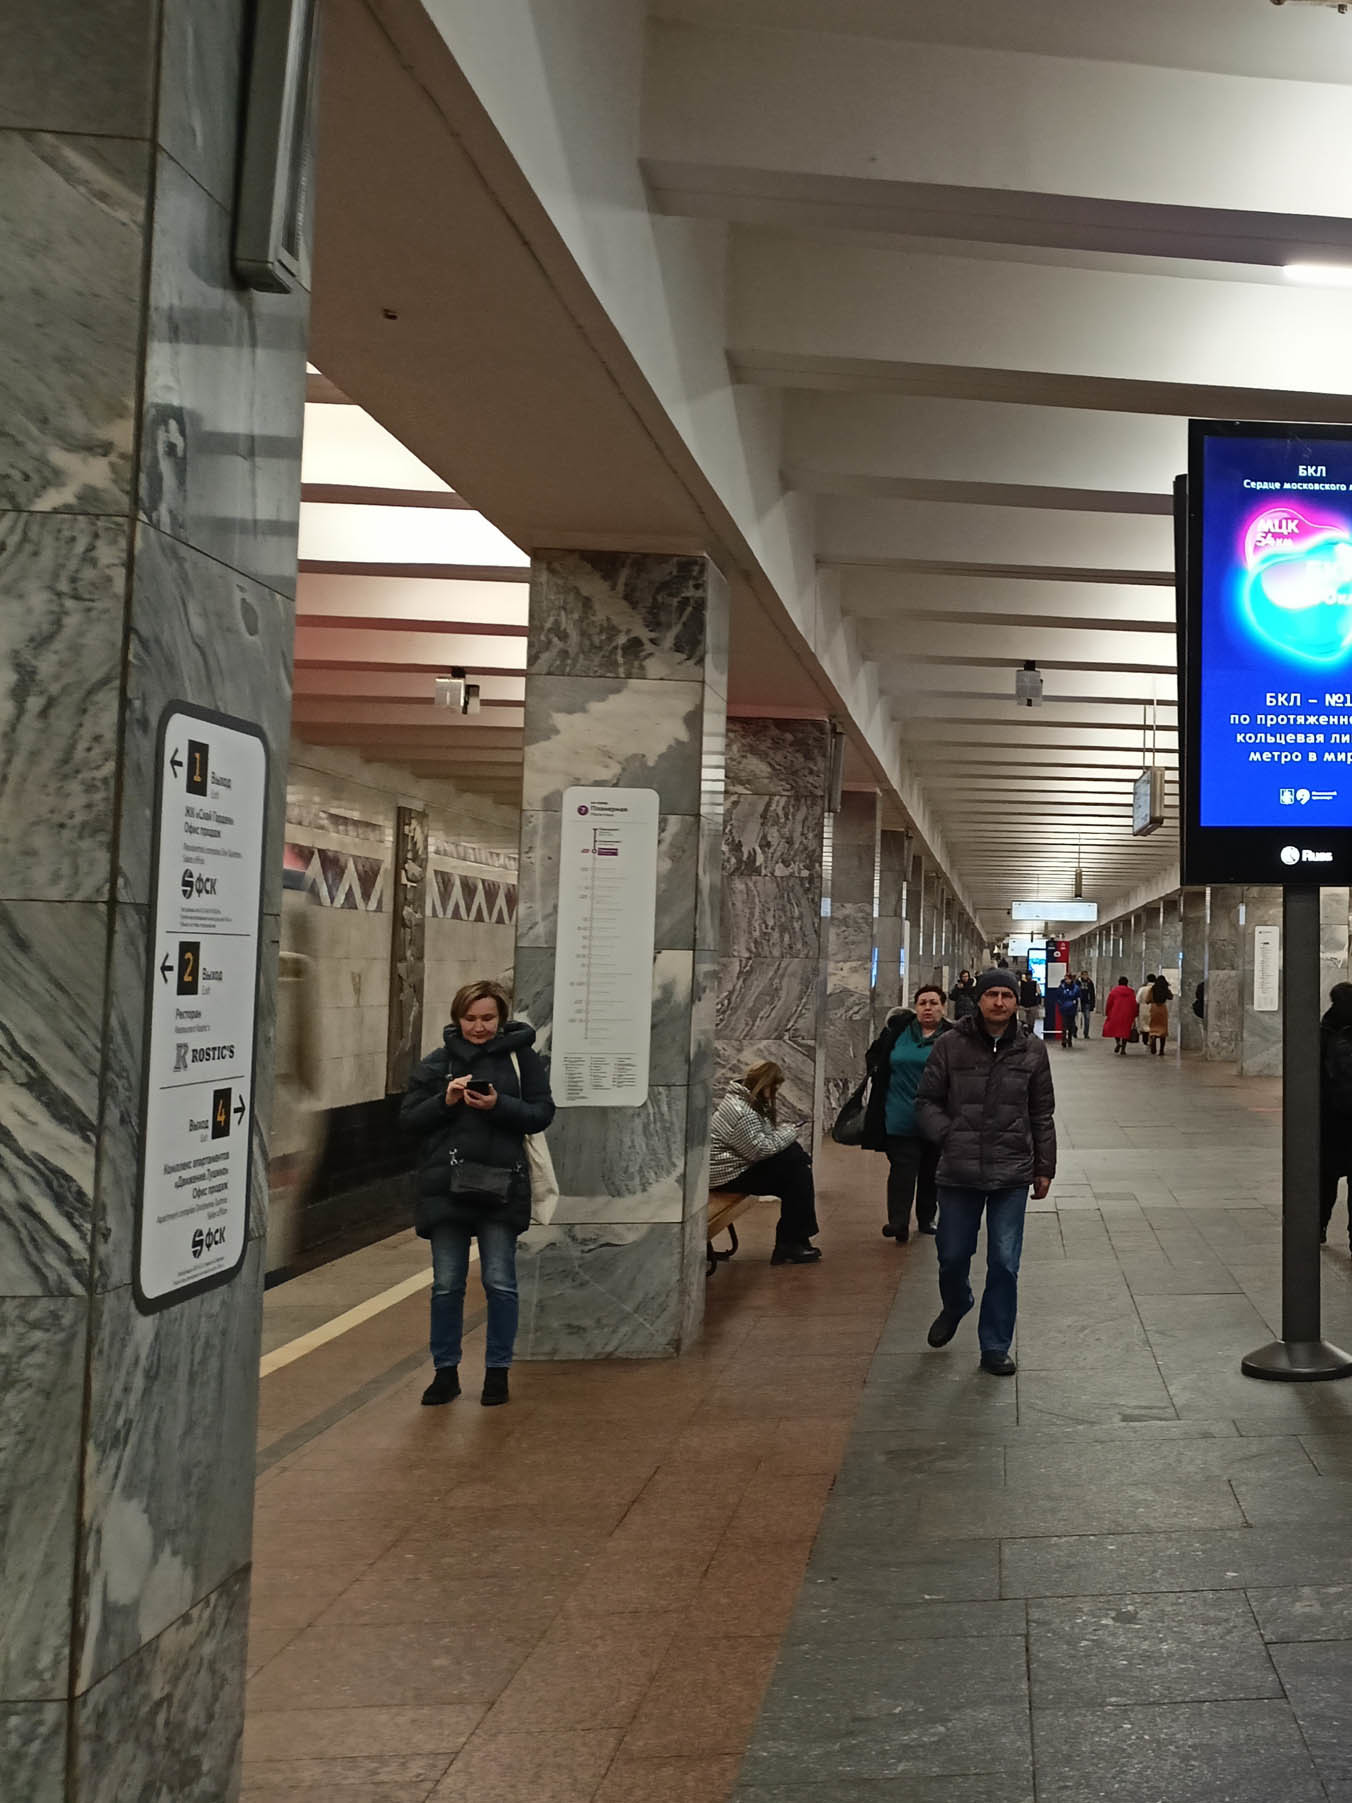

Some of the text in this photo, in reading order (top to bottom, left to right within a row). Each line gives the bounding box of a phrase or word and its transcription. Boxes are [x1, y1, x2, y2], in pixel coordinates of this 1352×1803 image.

[1298, 465, 1327, 477] БКЛ
[1243, 479, 1281, 491] Сердце
[1283, 481, 1347, 491] московского
[1265, 692, 1302, 707] БКЛ
[1324, 692, 1352, 707] №1
[1229, 713, 1251, 726] по
[1236, 733, 1325, 745] кольцевая
[1248, 750, 1302, 764] метро
[1308, 751, 1318, 762] в
[193, 752, 202, 782] 1
[183, 951, 194, 983] 2
[202, 967, 223, 982] Выход
[191, 1044, 235, 1064] ROSTIC'S
[188, 1099, 226, 1132] Выход 4
